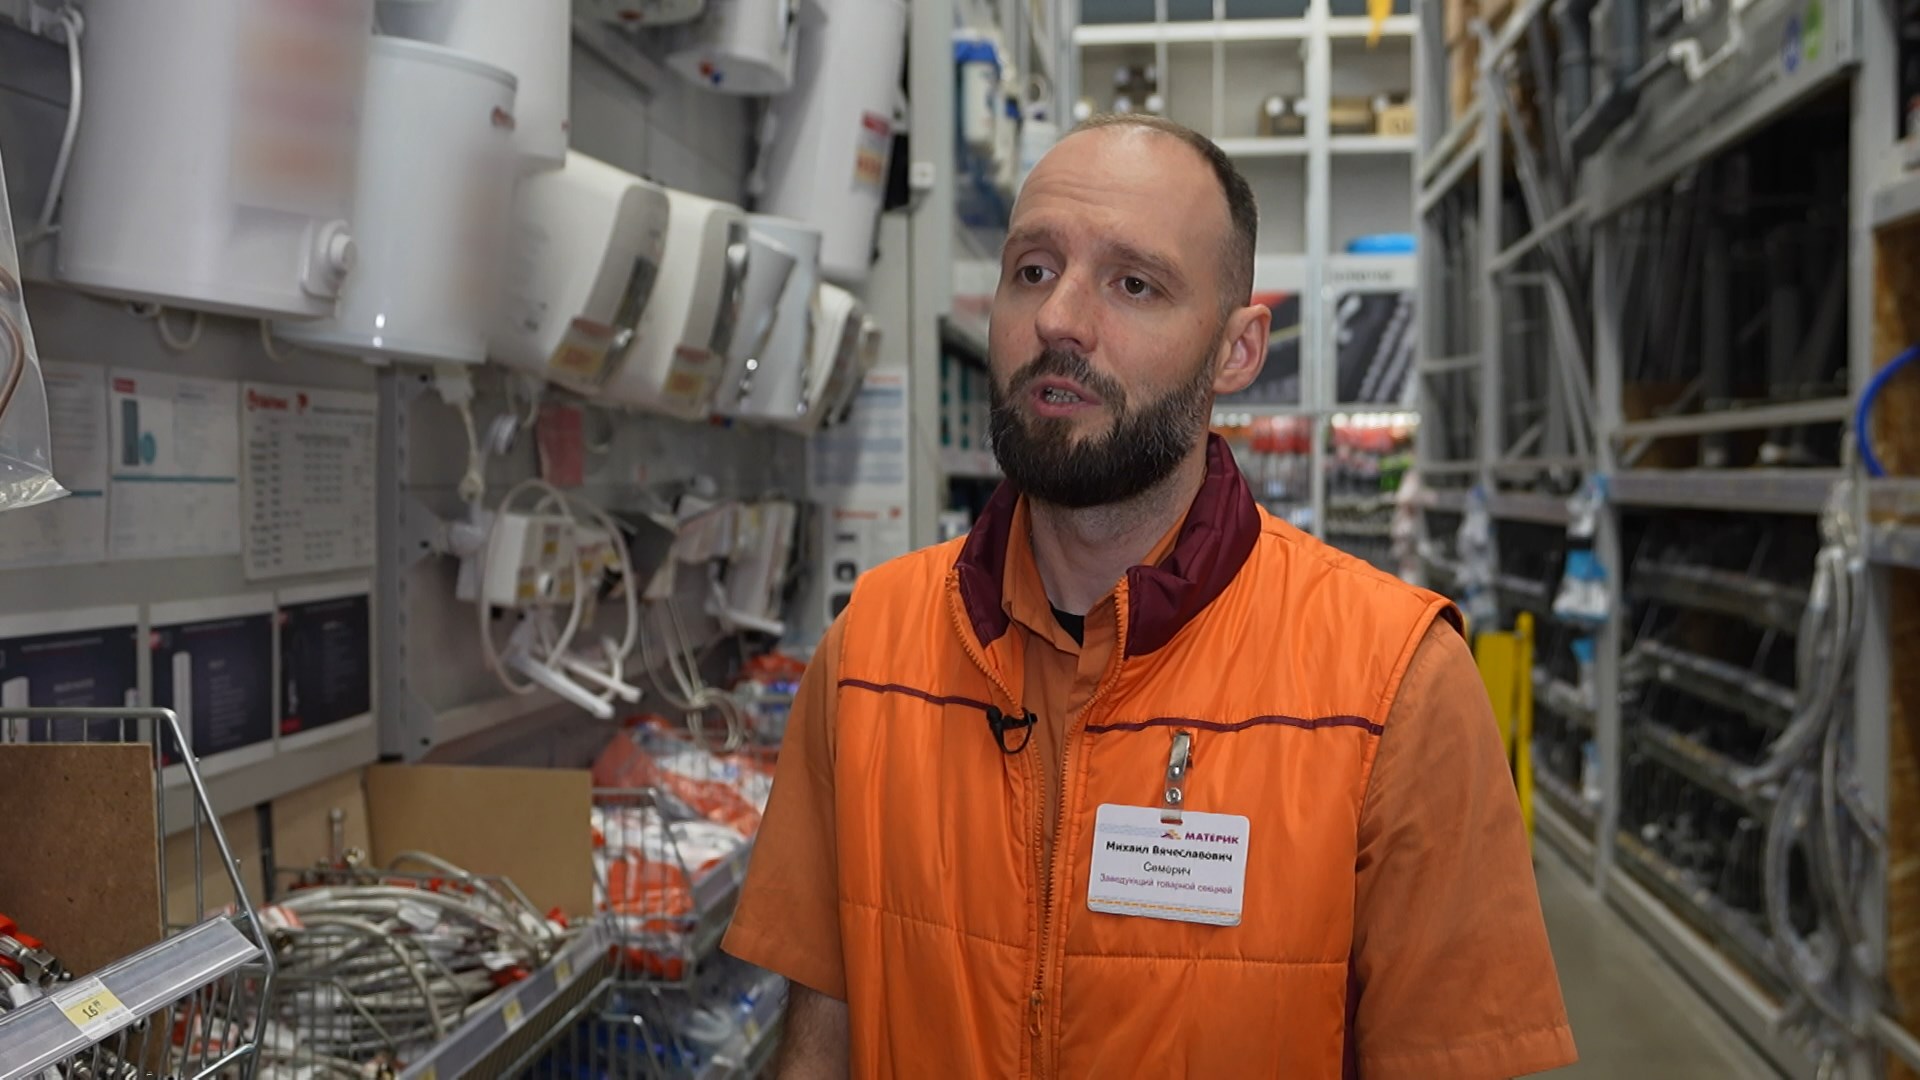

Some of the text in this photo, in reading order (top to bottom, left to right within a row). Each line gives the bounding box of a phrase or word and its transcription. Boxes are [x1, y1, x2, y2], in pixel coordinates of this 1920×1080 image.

[1184, 832, 1239, 844] МАТЕРИК
[1106, 840, 1232, 862] Михаил Вячеславович
[1100, 873, 1233, 894] Заведующий товарной секцией
